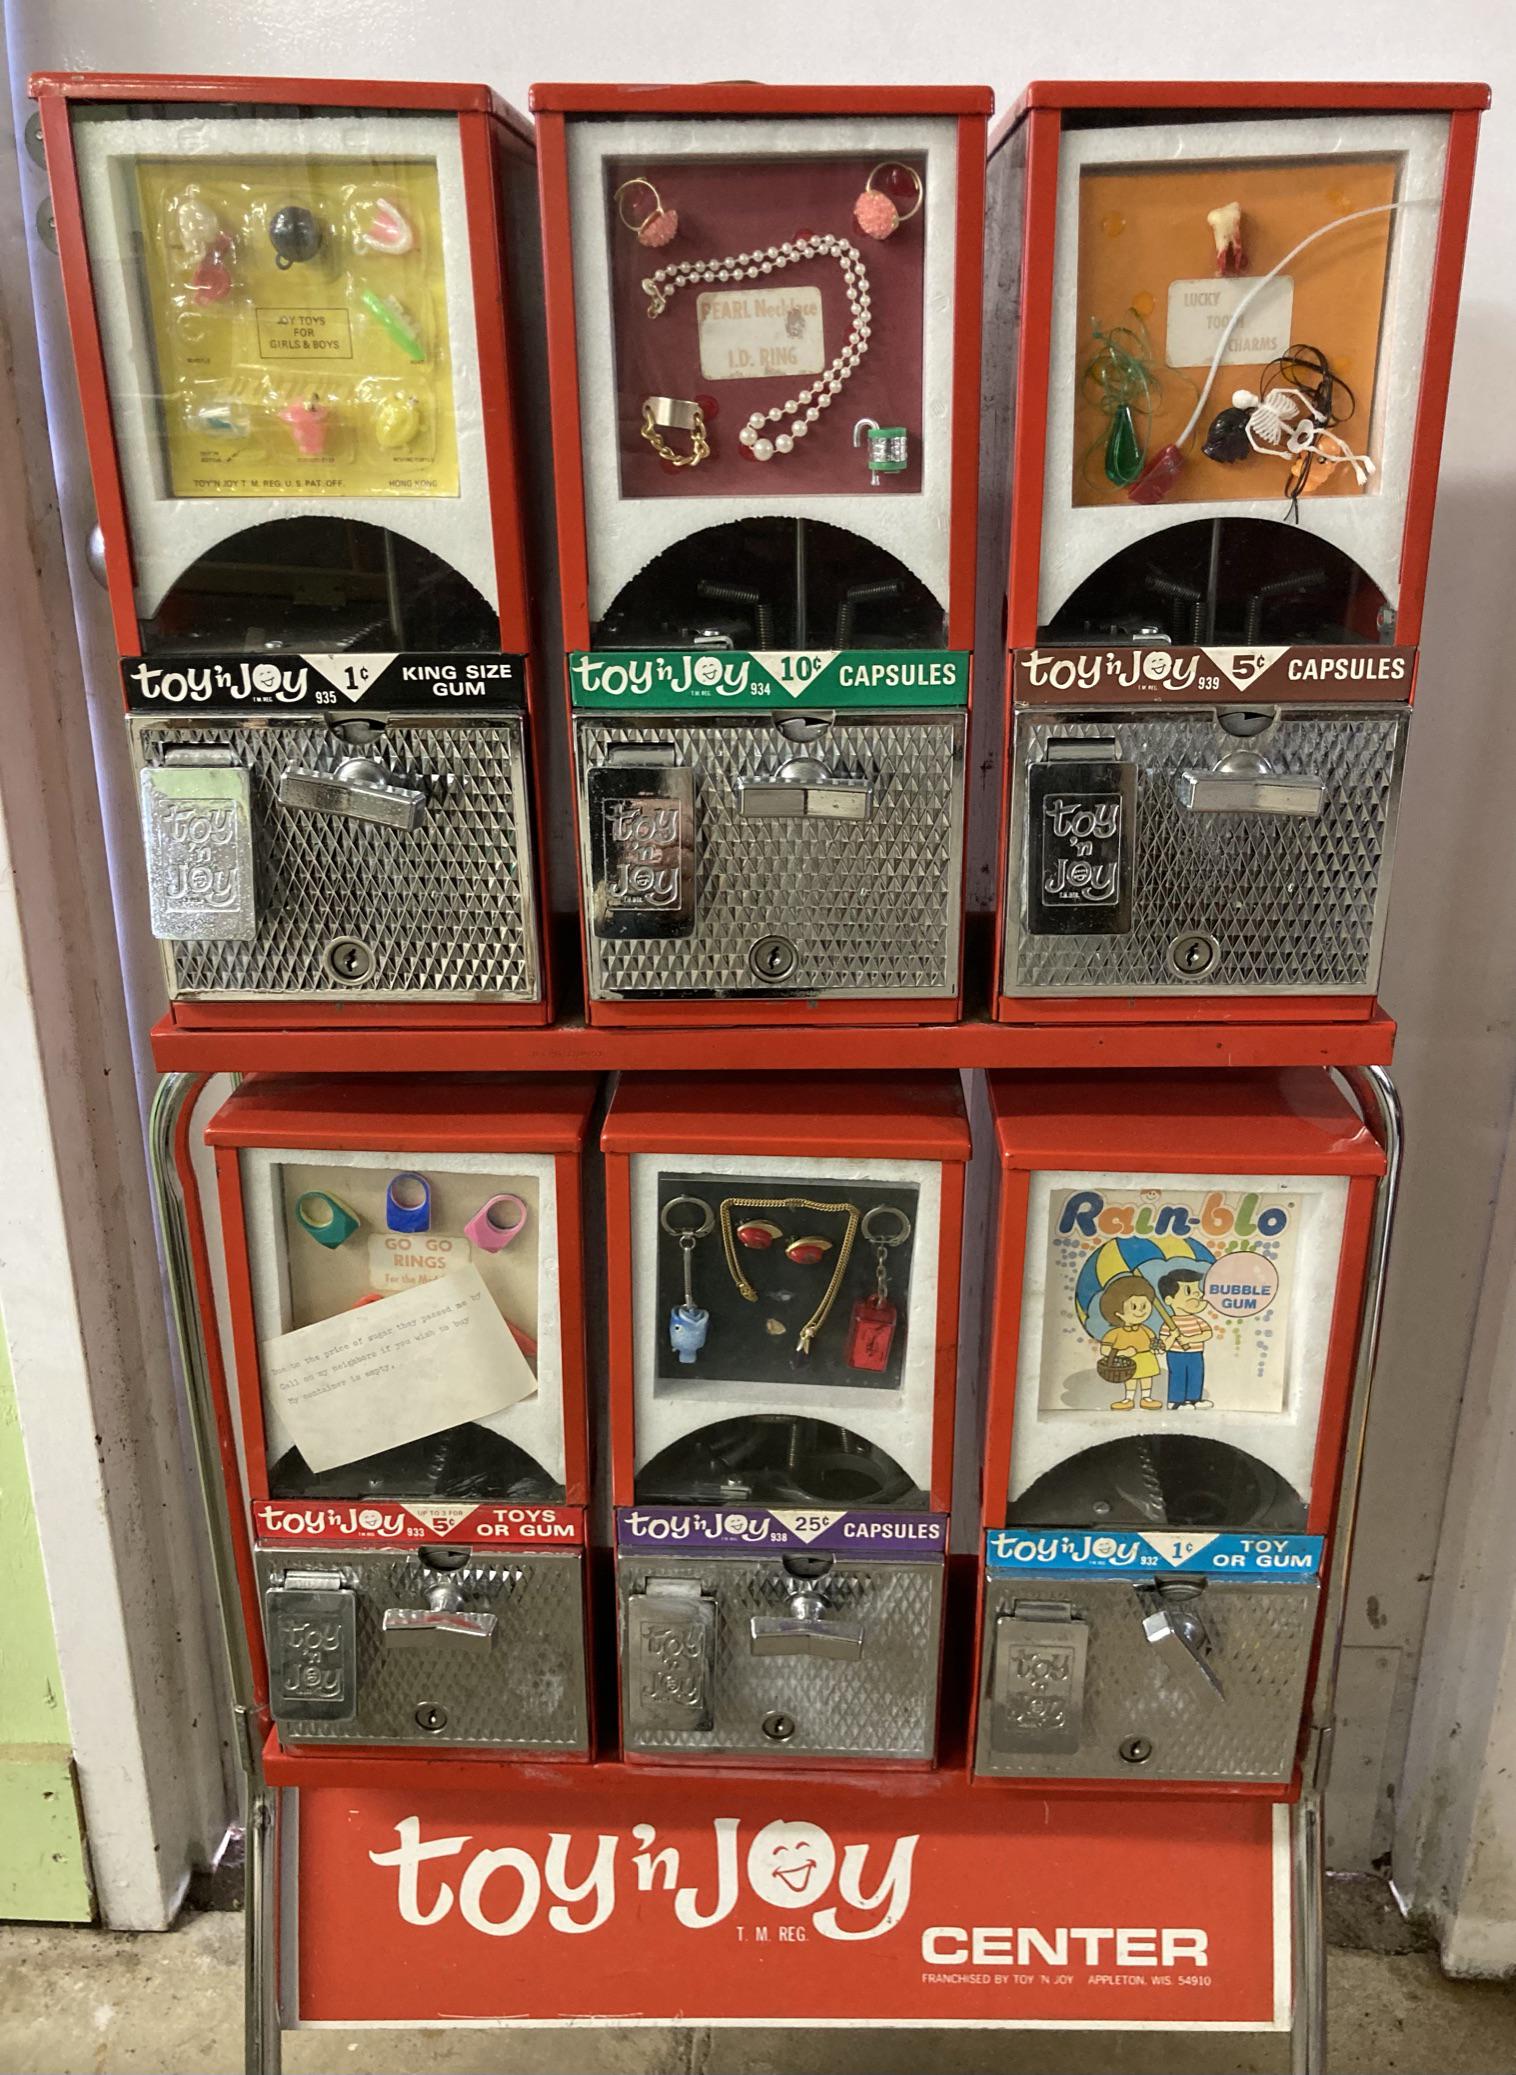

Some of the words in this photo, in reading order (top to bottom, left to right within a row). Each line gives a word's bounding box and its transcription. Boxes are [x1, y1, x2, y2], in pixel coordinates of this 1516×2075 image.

[1184, 291, 1221, 307] LUCKY
[701, 301, 750, 320] PEARL
[299, 316, 326, 326] TOYS
[1206, 314, 1245, 330] TOOH
[294, 328, 315, 337] FOR
[270, 340, 301, 349] GIRLS
[303, 341, 310, 349] &
[313, 340, 340, 349] BOYS
[1228, 337, 1278, 353] CHARMS
[760, 346, 798, 367] RING
[402, 666, 457, 681] KING
[466, 664, 512, 679] SIZE
[839, 663, 957, 687] CAPSULES
[1288, 658, 1405, 681] CAPSULES
[432, 681, 486, 696] GUM
[750, 682, 771, 696] 934
[1198, 676, 1220, 690] 939
[315, 691, 337, 704] 935
[385, 1238, 411, 1250] GO
[426, 1239, 453, 1252] GO
[394, 1254, 446, 1269] RINGS
[1209, 1284, 1271, 1296] BUBBLE
[1222, 1298, 1257, 1309] GUM
[304, 1354, 321, 1365] the
[324, 1343, 350, 1359] price
[353, 1337, 363, 1347] of
[368, 1329, 393, 1342] sugar
[396, 1319, 417, 1331] they
[493, 1509, 556, 1522] TOYS
[407, 1527, 425, 1537] 933
[476, 1524, 509, 1537] OR
[519, 1524, 575, 1537] GUM
[770, 1533, 788, 1542] 938
[843, 1523, 940, 1539] CAPSULES
[1240, 1540, 1289, 1553] TOY
[1140, 1556, 1159, 1566] 932
[1212, 1554, 1246, 1567] OR
[1255, 1555, 1313, 1567] GUM
[778, 1927, 809, 1943] REG.
[921, 1926, 1209, 1967] CENTER
[921, 1973, 991, 1984] FRANCHISED
[994, 1974, 1009, 1985] BY
[1013, 1974, 1033, 1985] TOY
[1054, 1974, 1074, 1986] JOY
[1177, 1976, 1212, 1987] 54910
